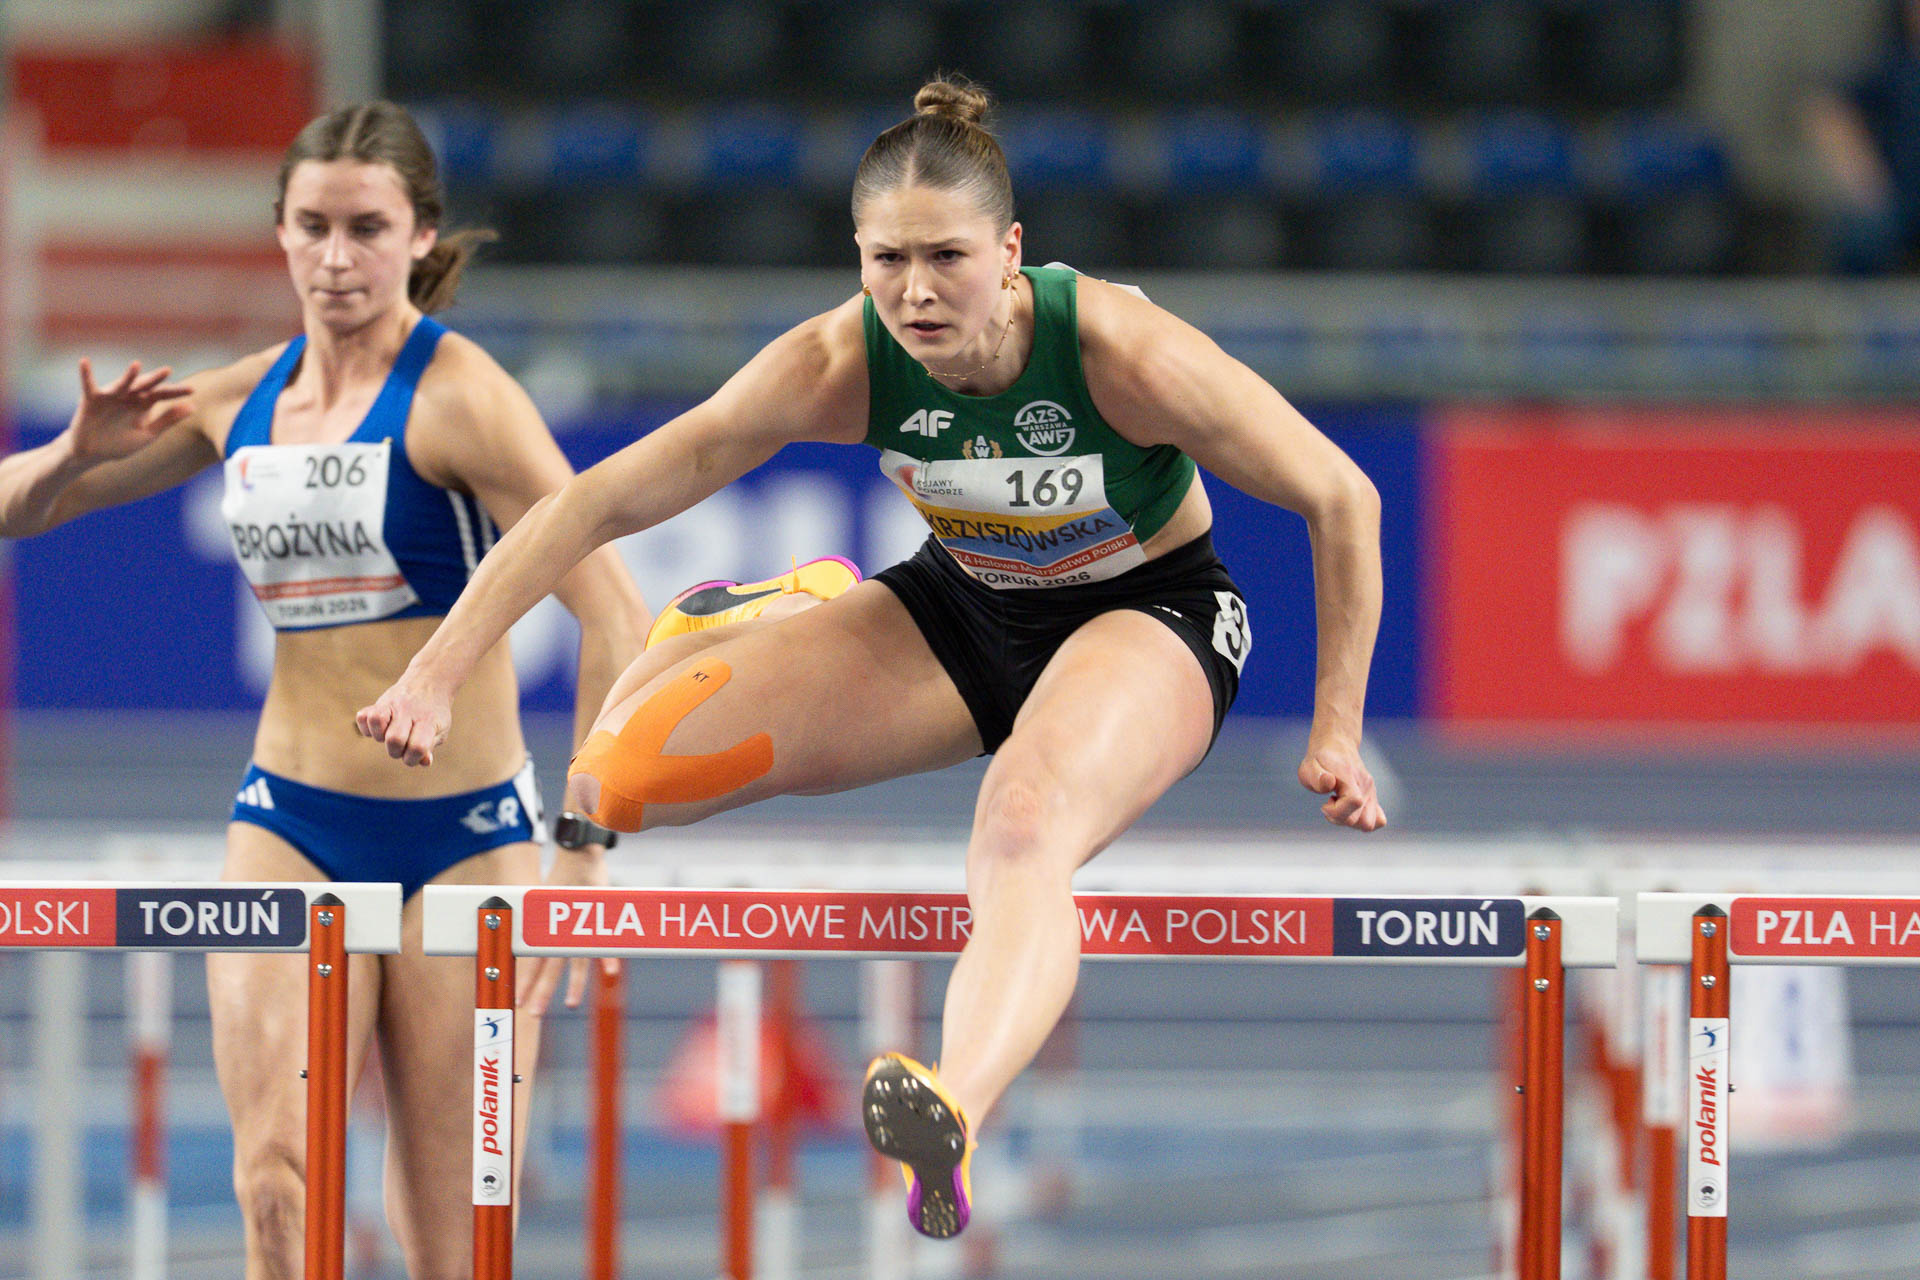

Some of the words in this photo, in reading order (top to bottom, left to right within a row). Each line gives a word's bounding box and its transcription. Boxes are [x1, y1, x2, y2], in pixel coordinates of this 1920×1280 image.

[900, 408, 955, 438] 4F
[1021, 421, 1068, 431] WARSZAWA
[1025, 408, 1060, 424] AZS
[1028, 429, 1067, 446] AWF
[305, 454, 366, 489] 206
[1005, 467, 1084, 508] 169
[232, 512, 380, 561] BROŻYNA
[921, 508, 1113, 553] KRZYSZOWSKA
[974, 556, 1018, 571] Halowe
[1019, 552, 1092, 577] Mistrzostwa
[1091, 537, 1129, 560] Polski
[973, 571, 1039, 587] TORUŃ
[1042, 571, 1092, 587] 2026
[692, 671, 710, 682] KT
[139, 890, 280, 936] TORUŃ
[549, 901, 645, 936] PZLA
[660, 902, 846, 940] HALOWE
[1165, 908, 1306, 945] POLSKI
[1356, 900, 1499, 946] TORUŃ
[1756, 910, 1855, 945] PZLA
[479, 1056, 504, 1157] polanik
[1695, 1065, 1721, 1167] polanik
